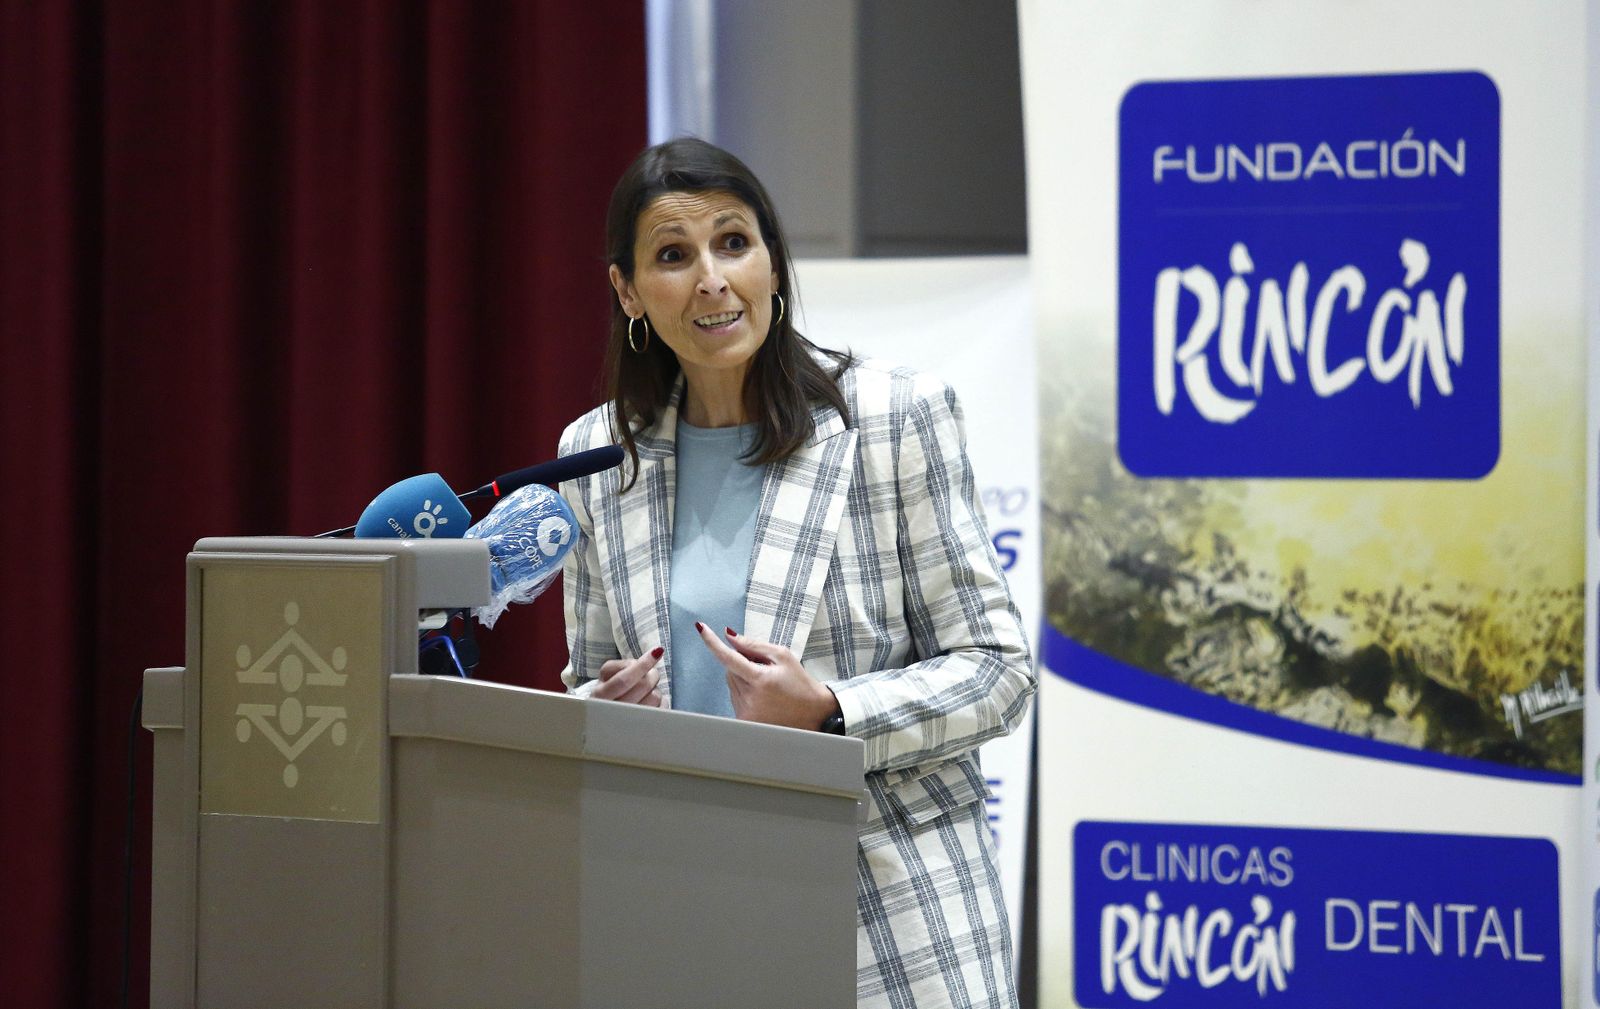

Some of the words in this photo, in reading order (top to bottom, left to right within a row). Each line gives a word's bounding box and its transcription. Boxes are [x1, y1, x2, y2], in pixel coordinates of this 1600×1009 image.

[1153, 128, 1466, 183] FUNDACIÓN
[519, 537, 543, 570] COPE
[1100, 840, 1294, 887] CLINICAS
[1324, 897, 1546, 963] DENTAL
